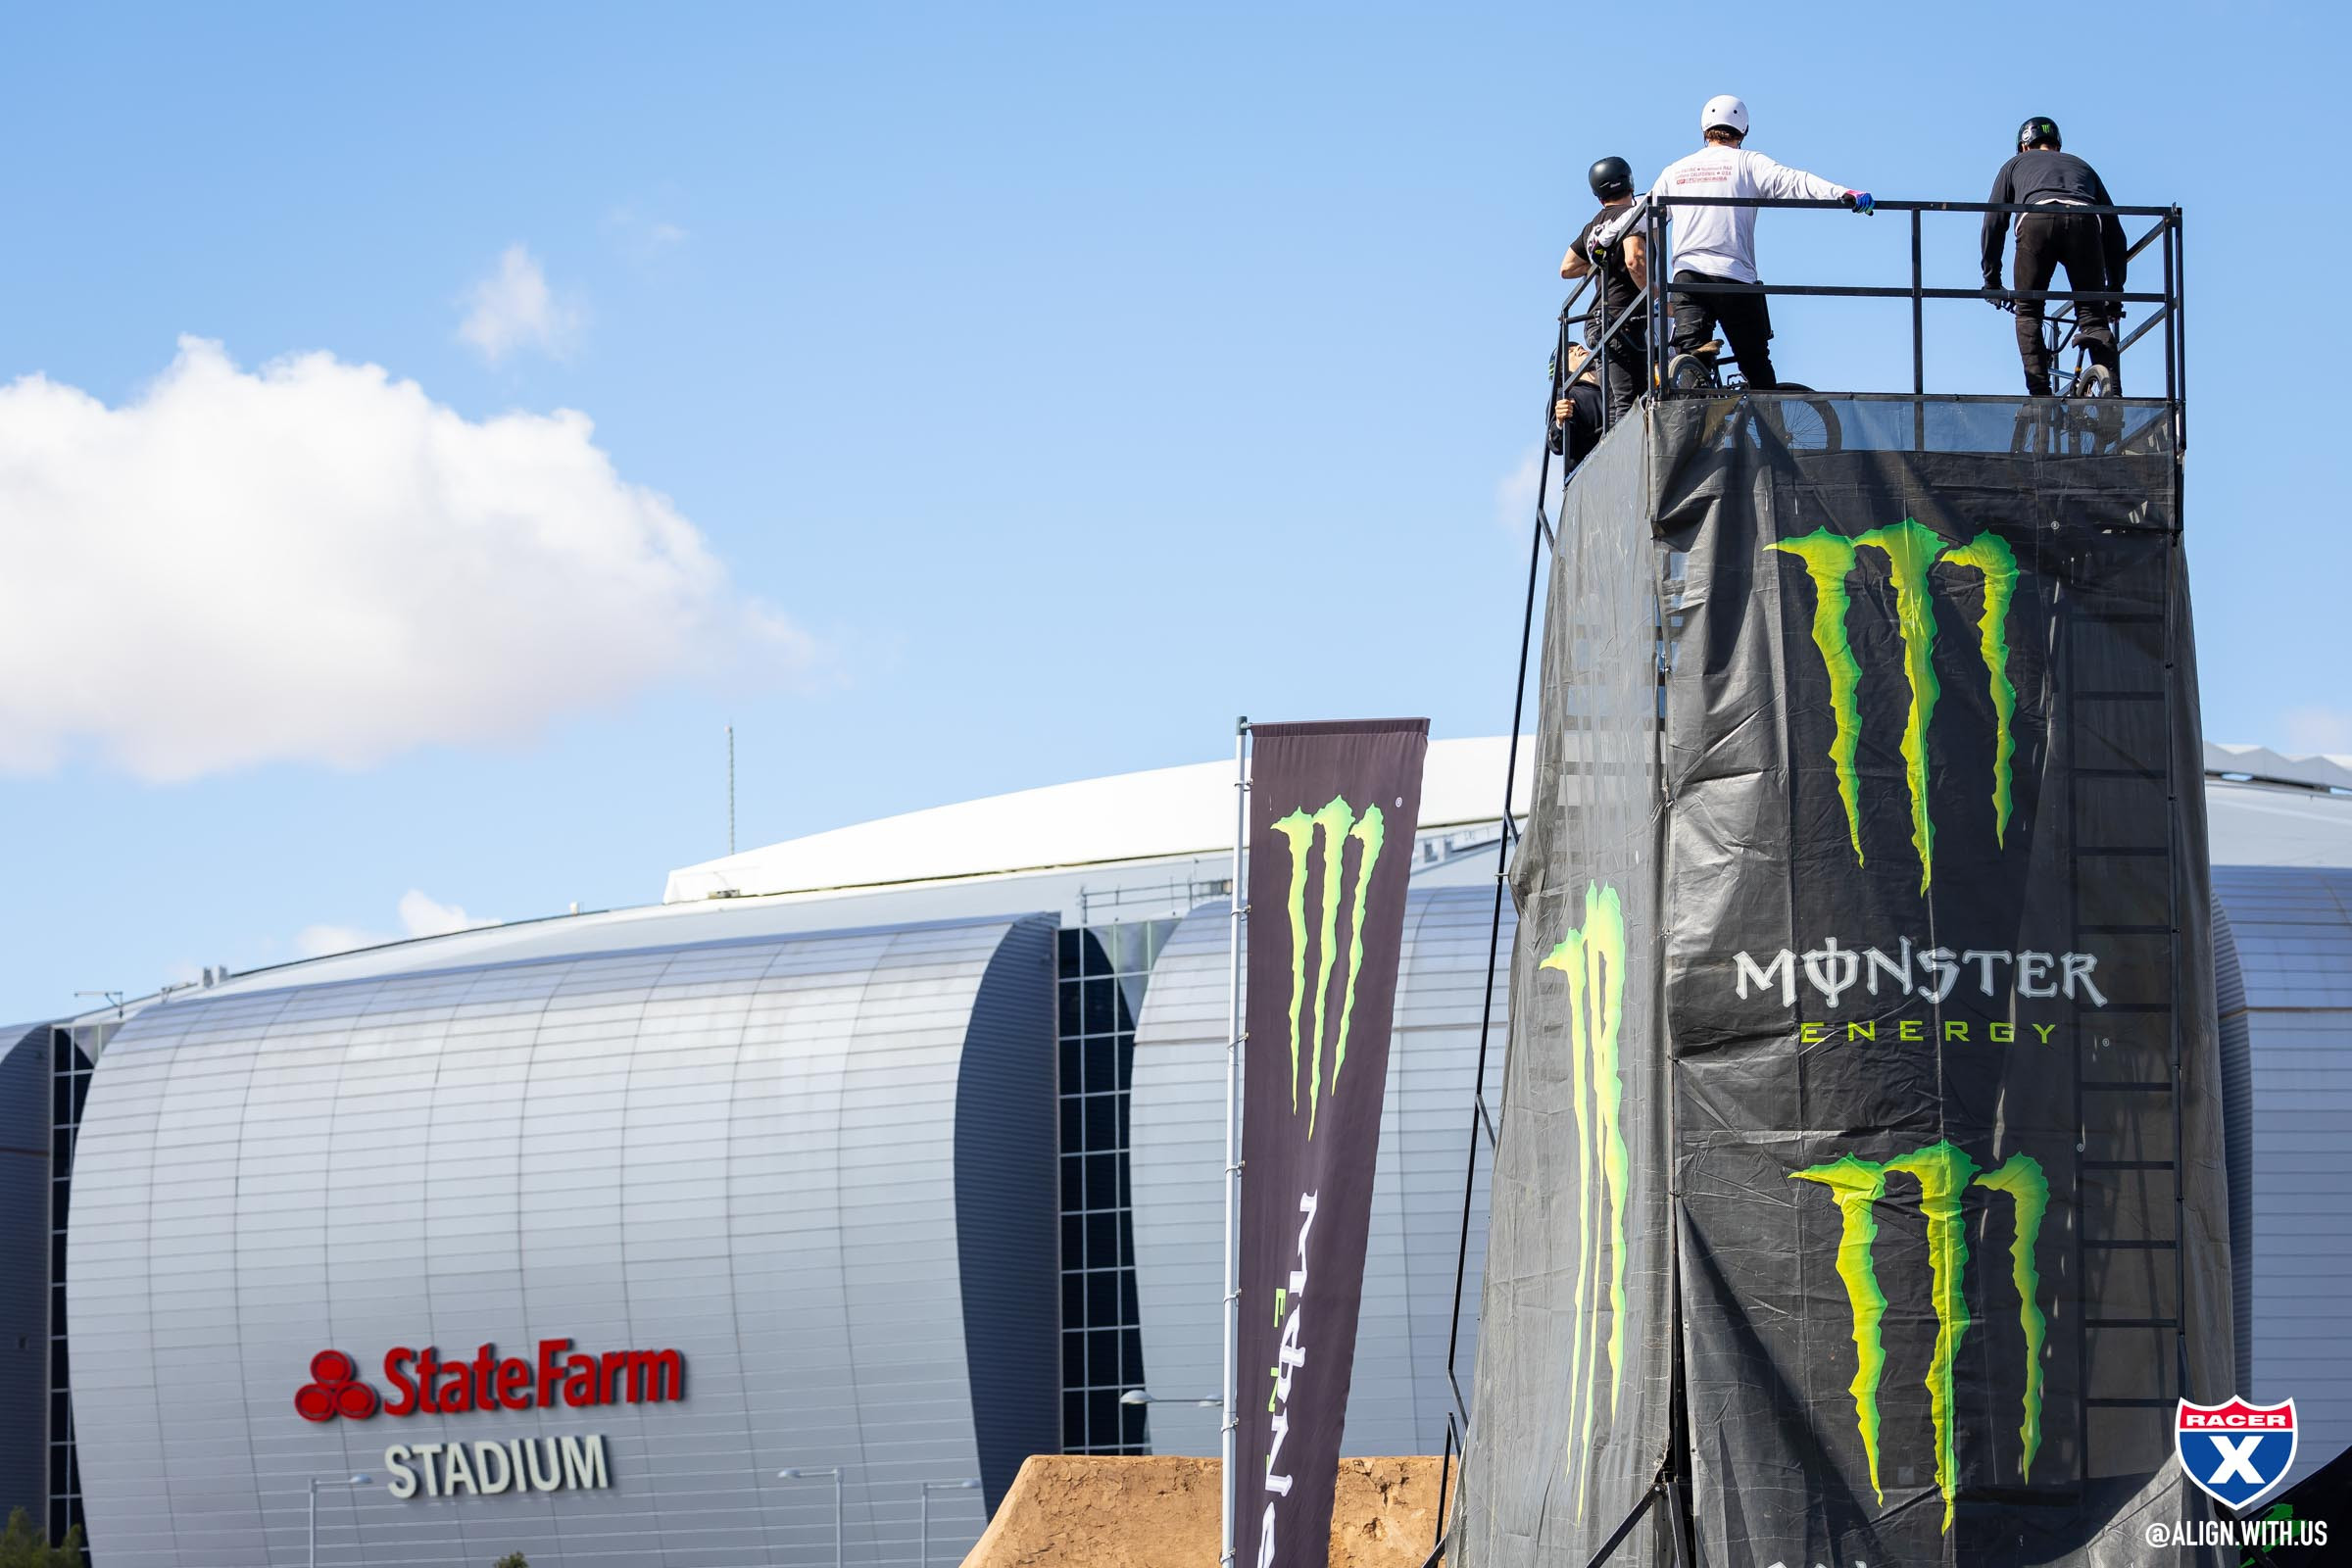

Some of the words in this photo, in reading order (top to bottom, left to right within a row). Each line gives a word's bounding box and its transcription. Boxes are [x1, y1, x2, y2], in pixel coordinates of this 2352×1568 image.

[1733, 936, 2108, 1008] MONSTER
[1800, 1020, 2056, 1044] ENERGY
[384, 1435, 610, 1498] STADIUM
